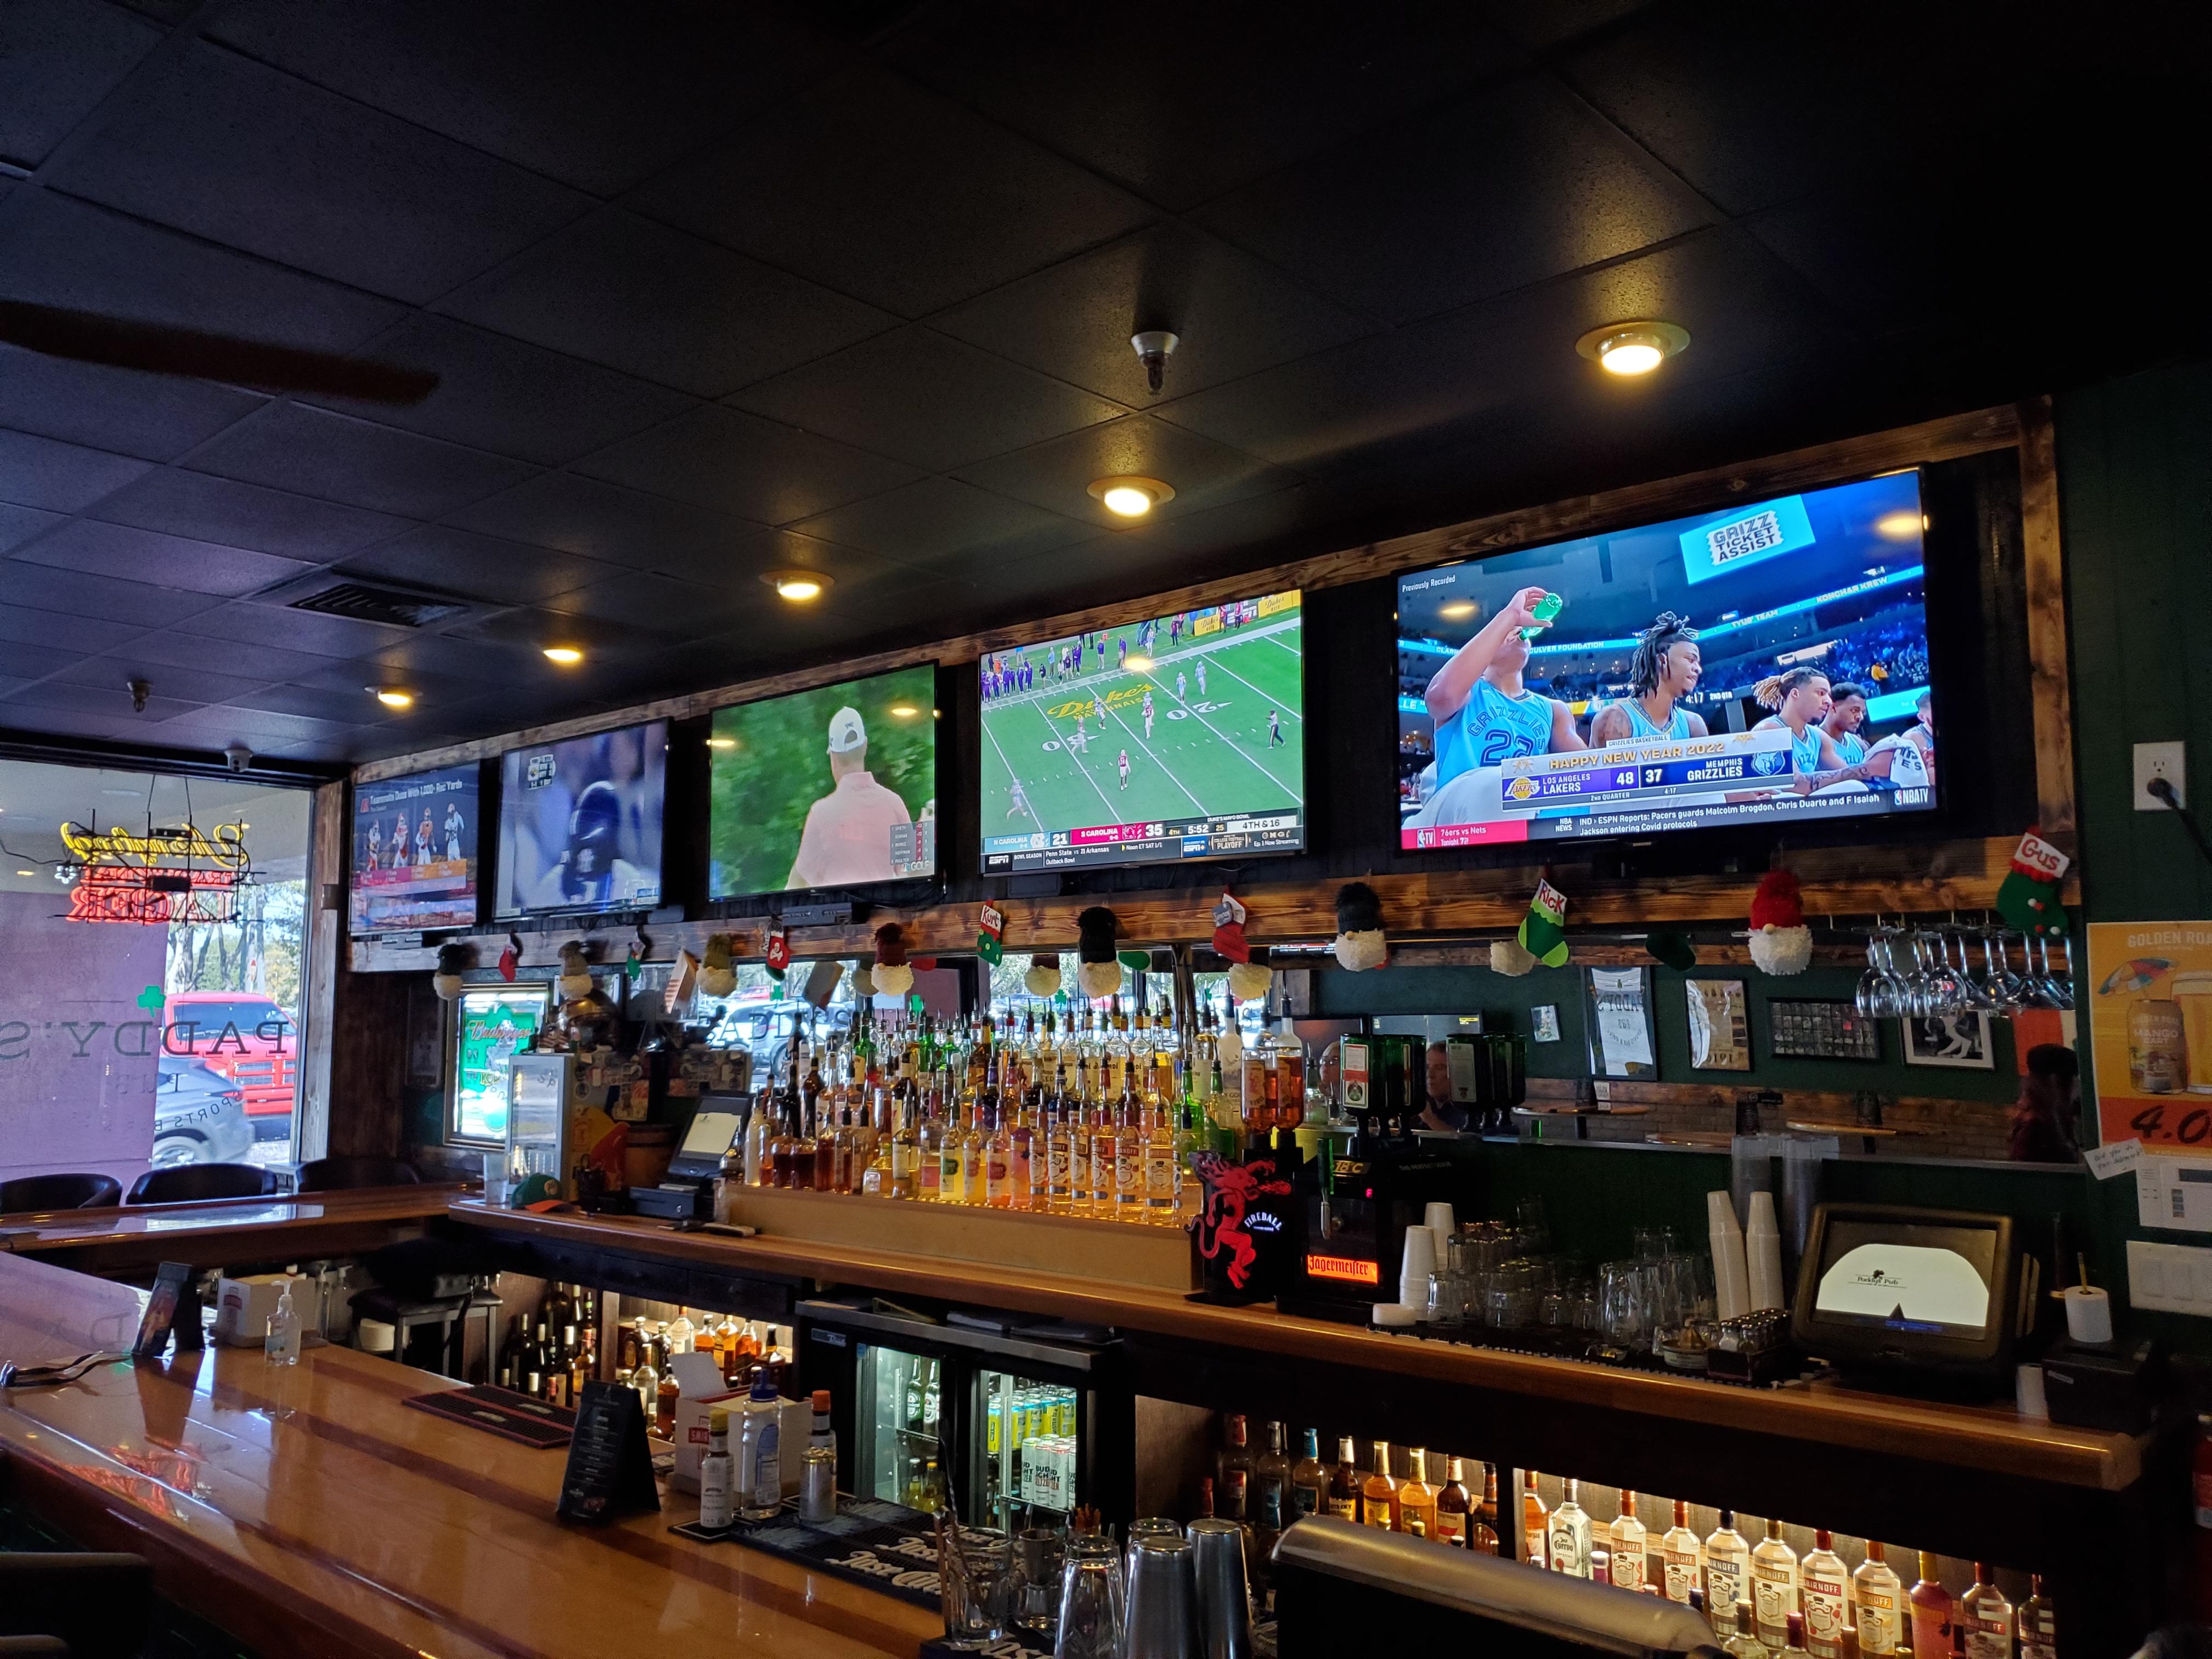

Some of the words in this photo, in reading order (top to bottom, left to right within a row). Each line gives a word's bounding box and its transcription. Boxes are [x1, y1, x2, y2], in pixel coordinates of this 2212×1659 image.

[1713, 513, 1772, 545] GRIZZ
[1716, 526, 1773, 551] TICKET
[1719, 534, 1775, 562] ASSIST
[1402, 581, 1429, 593] Previously
[1431, 574, 1456, 586] Recorded
[1860, 577, 1888, 590] KREW
[1558, 641, 1604, 651] FOUNDATION
[1047, 684, 1156, 719] Duke's
[1685, 693, 1704, 704] 4:17
[1468, 706, 1546, 750] GRIZZLIES
[1609, 738, 1634, 747] GRIZZLIES
[1634, 735, 1668, 744] BASKETBALL
[1481, 729, 1534, 767] 22
[1549, 755, 1599, 770] HAPPY
[1603, 751, 1637, 764] NEW
[1640, 746, 1682, 760] YEAR
[1687, 742, 1725, 755] 2022
[1706, 758, 1743, 768] MEMPHIS
[1543, 777, 1557, 785] LOS
[1558, 774, 1590, 783] ANGELES
[1616, 771, 1634, 785] 48
[1645, 769, 1662, 783] 37
[1687, 766, 1743, 781] GRIZZLIES
[1543, 782, 1581, 794] LAKERS
[1602, 792, 1630, 800] QUARTER
[1903, 788, 1928, 804] NBATV
[1598, 816, 1618, 824] ESPN
[1619, 814, 1650, 823] Reports:
[1651, 811, 1676, 820] Pacers
[1678, 809, 1704, 820] guards
[1705, 805, 1738, 815] Malcolm
[1739, 802, 1775, 814] Brogdon,
[1776, 801, 1797, 810] Chris
[1799, 798, 1827, 808] Duarte
[1829, 797, 1845, 806] and
[1846, 795, 1852, 805] F
[1853, 794, 1880, 804] Isaiah
[1145, 823, 1163, 836] 35
[1187, 825, 1209, 834] 5:52
[1243, 821, 1261, 830] 4TH
[1269, 819, 1280, 827] 16
[1579, 827, 1608, 836] Jackson
[1610, 825, 1640, 834] entering
[1641, 823, 1661, 831] Covid
[1663, 820, 1697, 830] protocols
[1086, 827, 1118, 837] CAROLINA
[1441, 828, 1460, 837] 76ers
[1470, 826, 1486, 834] Nets
[998, 837, 1028, 845] CAROLINA
[1052, 833, 1068, 845] 21
[1217, 841, 1242, 850] PLAYOFF
[1275, 837, 1300, 845] Streaming
[1440, 839, 1459, 848] Tonight
[989, 855, 1009, 865] ESPN
[2021, 838, 2061, 871] Gus
[911, 860, 930, 871] GOLF
[982, 906, 999, 927] Kurt
[2128, 930, 2181, 948] GOLDEN
[2134, 1029, 2179, 1038] MANGO
[1244, 1211, 1282, 1231] FIREBALL
[692, 1431, 708, 1441] SMIR
[1554, 1539, 1573, 1552] Cuervo
